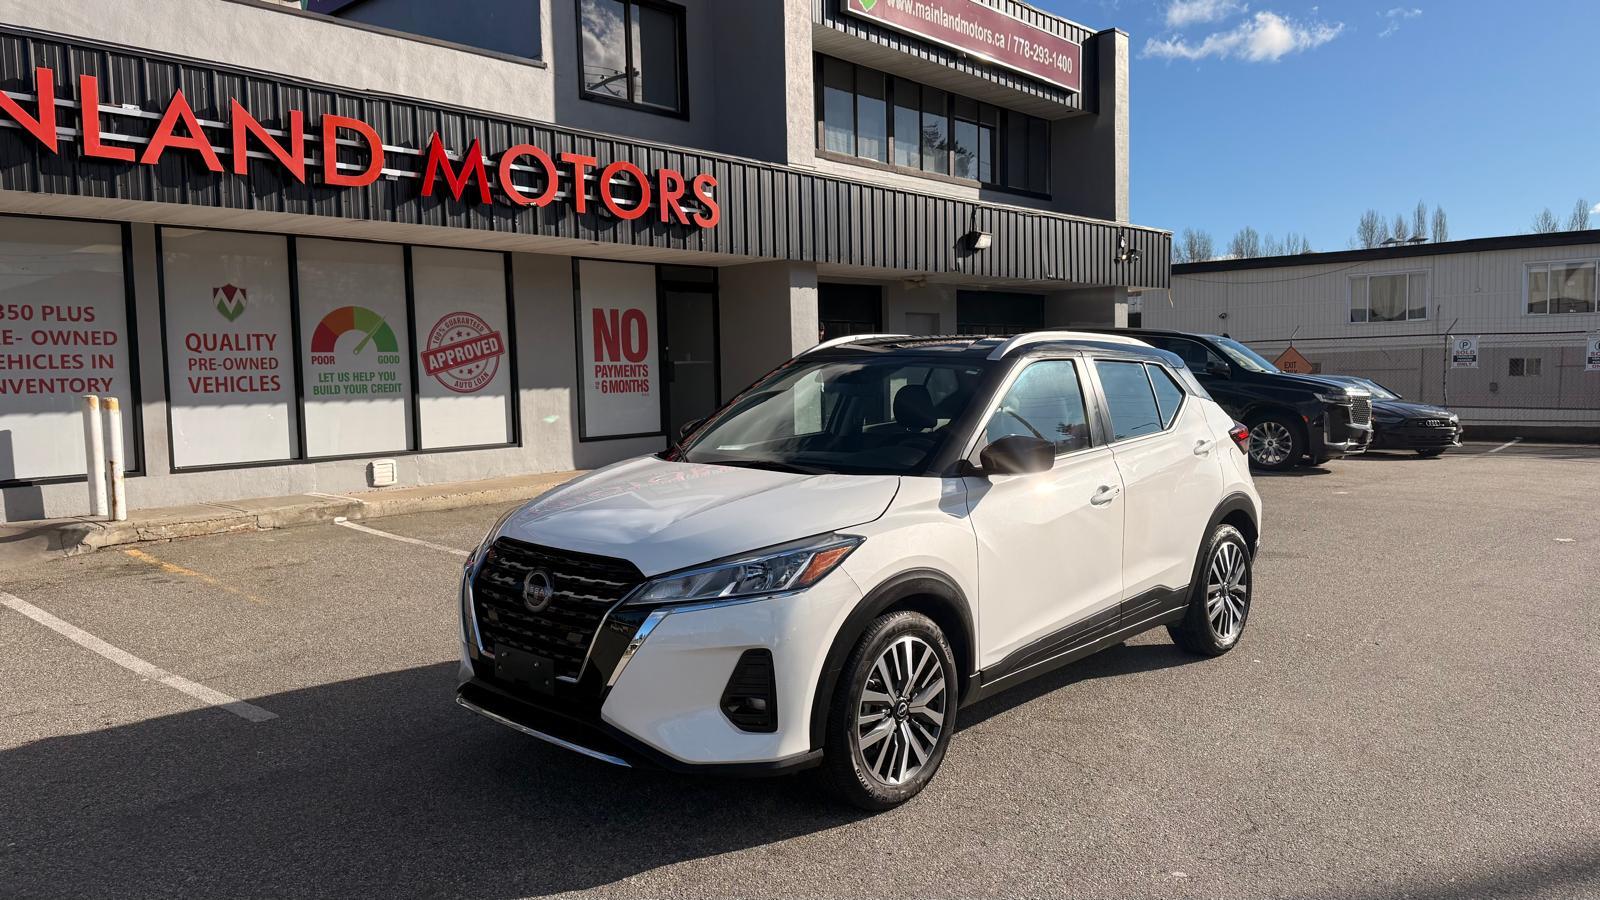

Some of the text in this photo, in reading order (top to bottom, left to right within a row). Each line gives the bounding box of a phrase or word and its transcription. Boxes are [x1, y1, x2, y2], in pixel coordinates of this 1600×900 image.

[887, 0, 1073, 75] www.mainlandmotors.ca / 778-293-1400
[0, 66, 720, 228] NLAND MOTORS
[42, 305, 95, 323] PLUS
[0, 329, 118, 346] E- OWNED
[432, 316, 485, 345] 100% GUARANTEED
[592, 308, 648, 363] NO
[185, 333, 277, 354] QUALITY
[91, 354, 114, 369] IN
[311, 355, 336, 365] POOR
[377, 354, 400, 364] GOOD
[428, 337, 499, 370] APPROVED
[188, 357, 279, 371] PRE-OWNED
[594, 364, 649, 378] PAYMENTS
[1284, 361, 1297, 369] EXIT
[188, 375, 281, 394] VEHICLES
[318, 371, 396, 383] LET US HELP YOU
[454, 371, 489, 389] AUTO LOAN
[313, 383, 402, 396] BUILD YOUR CREDIT
[601, 380, 608, 394] 6
[609, 379, 650, 393] MONTHS
